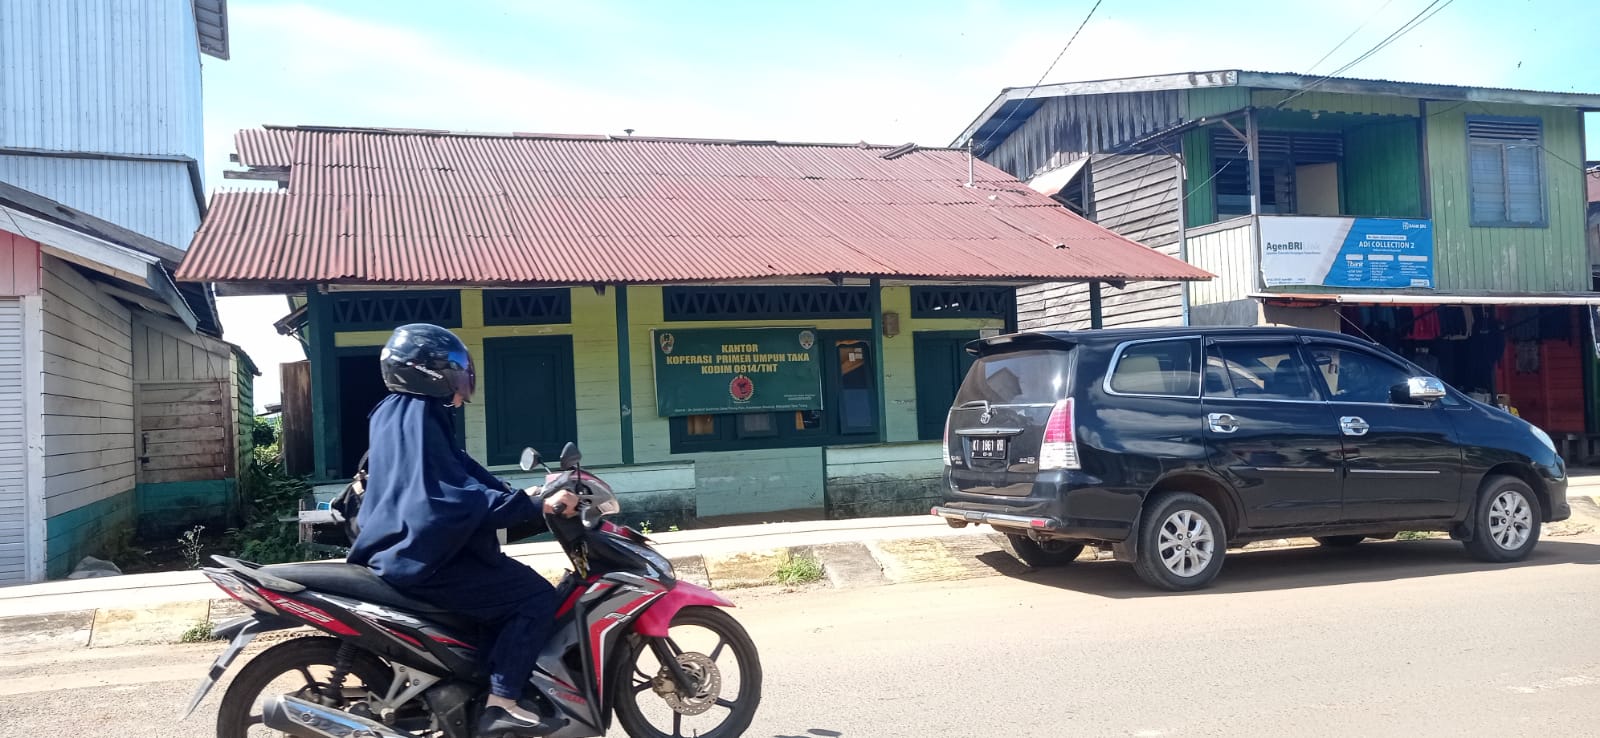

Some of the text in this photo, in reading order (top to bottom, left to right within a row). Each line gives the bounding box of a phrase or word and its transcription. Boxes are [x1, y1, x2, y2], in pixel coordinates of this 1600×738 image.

[1371, 241, 1409, 249] COLLECTION
[721, 344, 759, 353] KANTOR
[666, 353, 810, 365] KOPERASI PRIMER UMPUN TAKA
[701, 363, 778, 375] KODIM 0914/TNT
